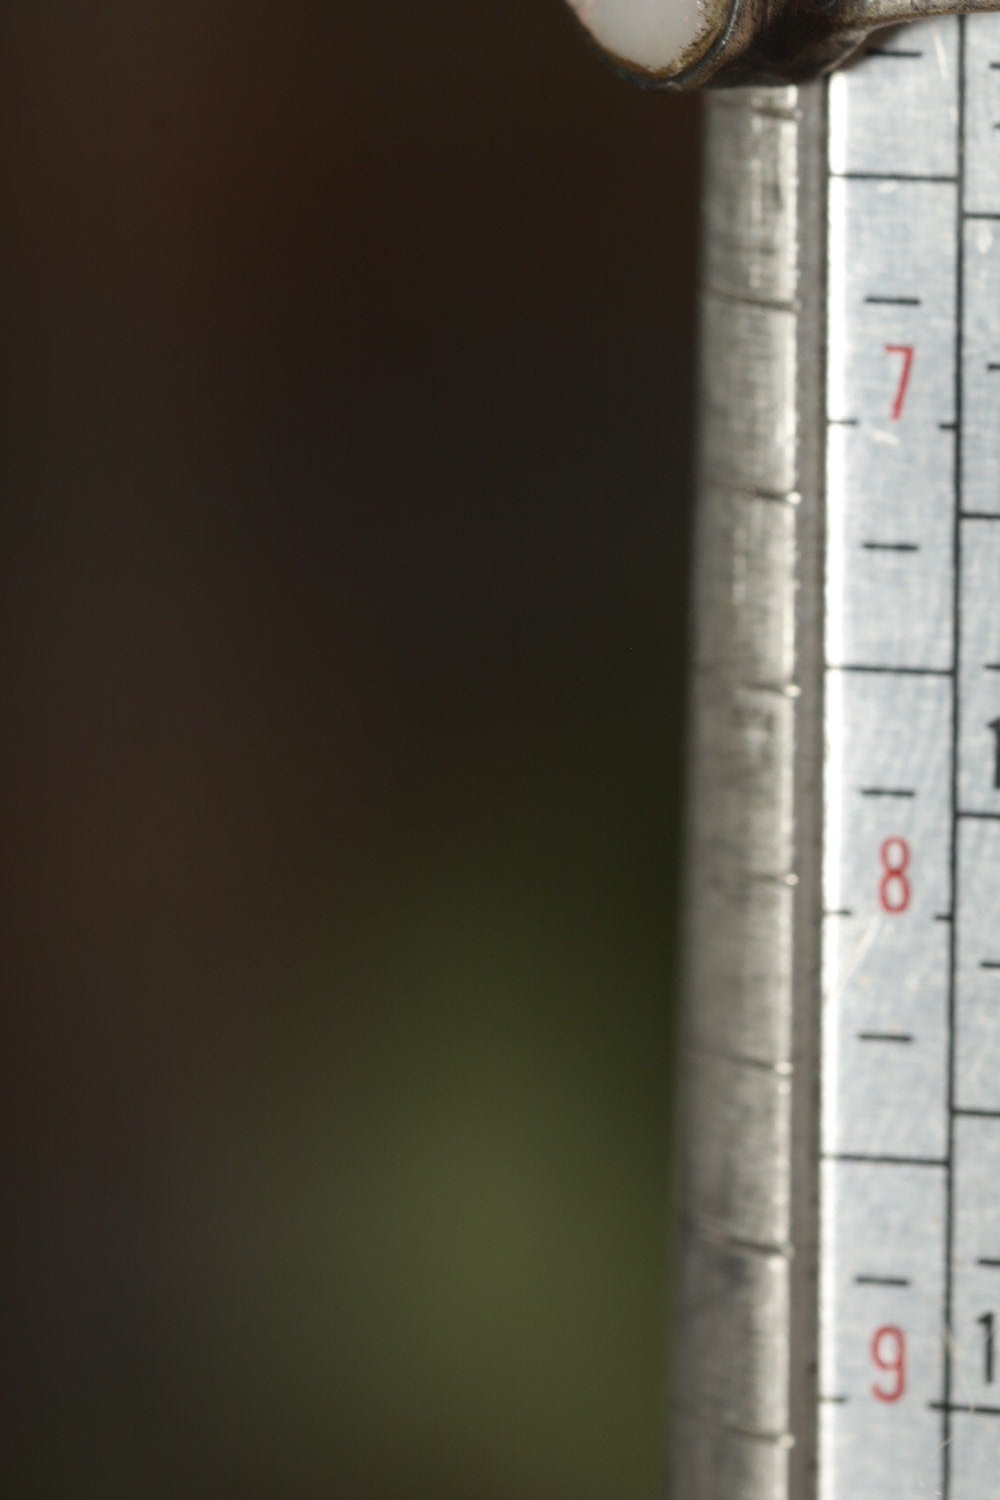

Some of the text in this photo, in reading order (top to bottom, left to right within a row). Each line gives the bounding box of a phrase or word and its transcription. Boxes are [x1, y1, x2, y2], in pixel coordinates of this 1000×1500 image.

[882, 343, 915, 422] 7
[876, 835, 911, 916] 8
[870, 1325, 907, 1404] 9
